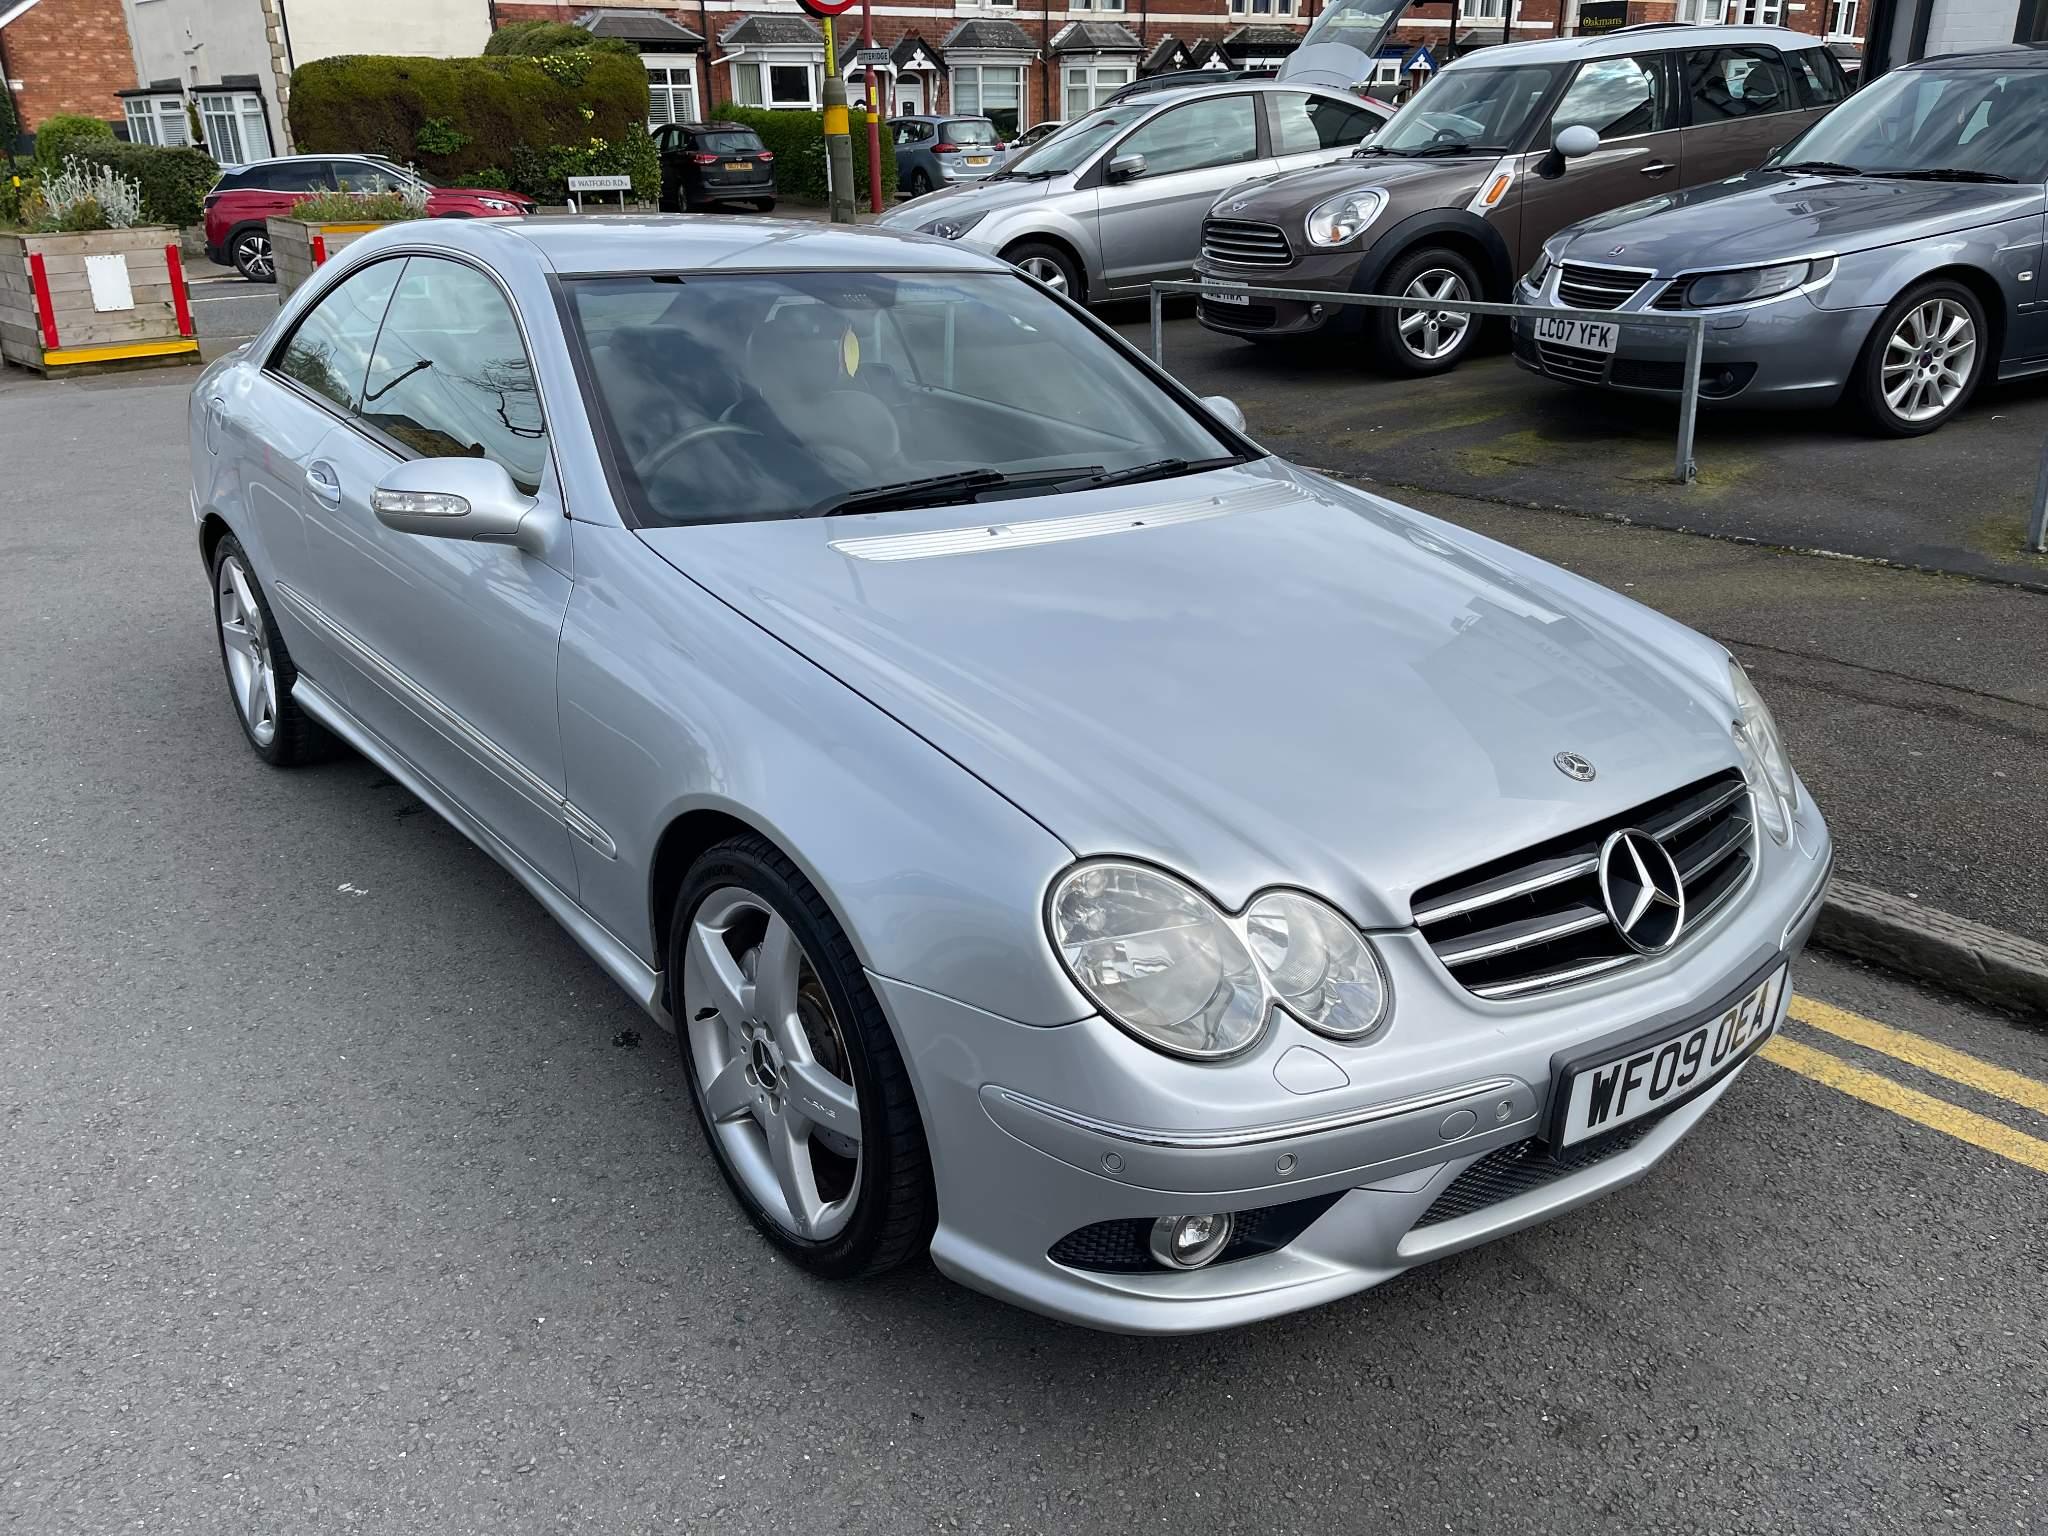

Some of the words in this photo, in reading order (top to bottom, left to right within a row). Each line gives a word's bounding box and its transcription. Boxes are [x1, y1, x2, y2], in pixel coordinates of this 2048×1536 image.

[1583, 16, 1622, 27] Oakmans
[577, 179, 611, 187] WATFORD
[1539, 317, 1575, 341] LC07
[1580, 322, 1611, 348] YFK
[1587, 1028, 1708, 1128] WF09
[1710, 979, 1769, 1067] OEA
